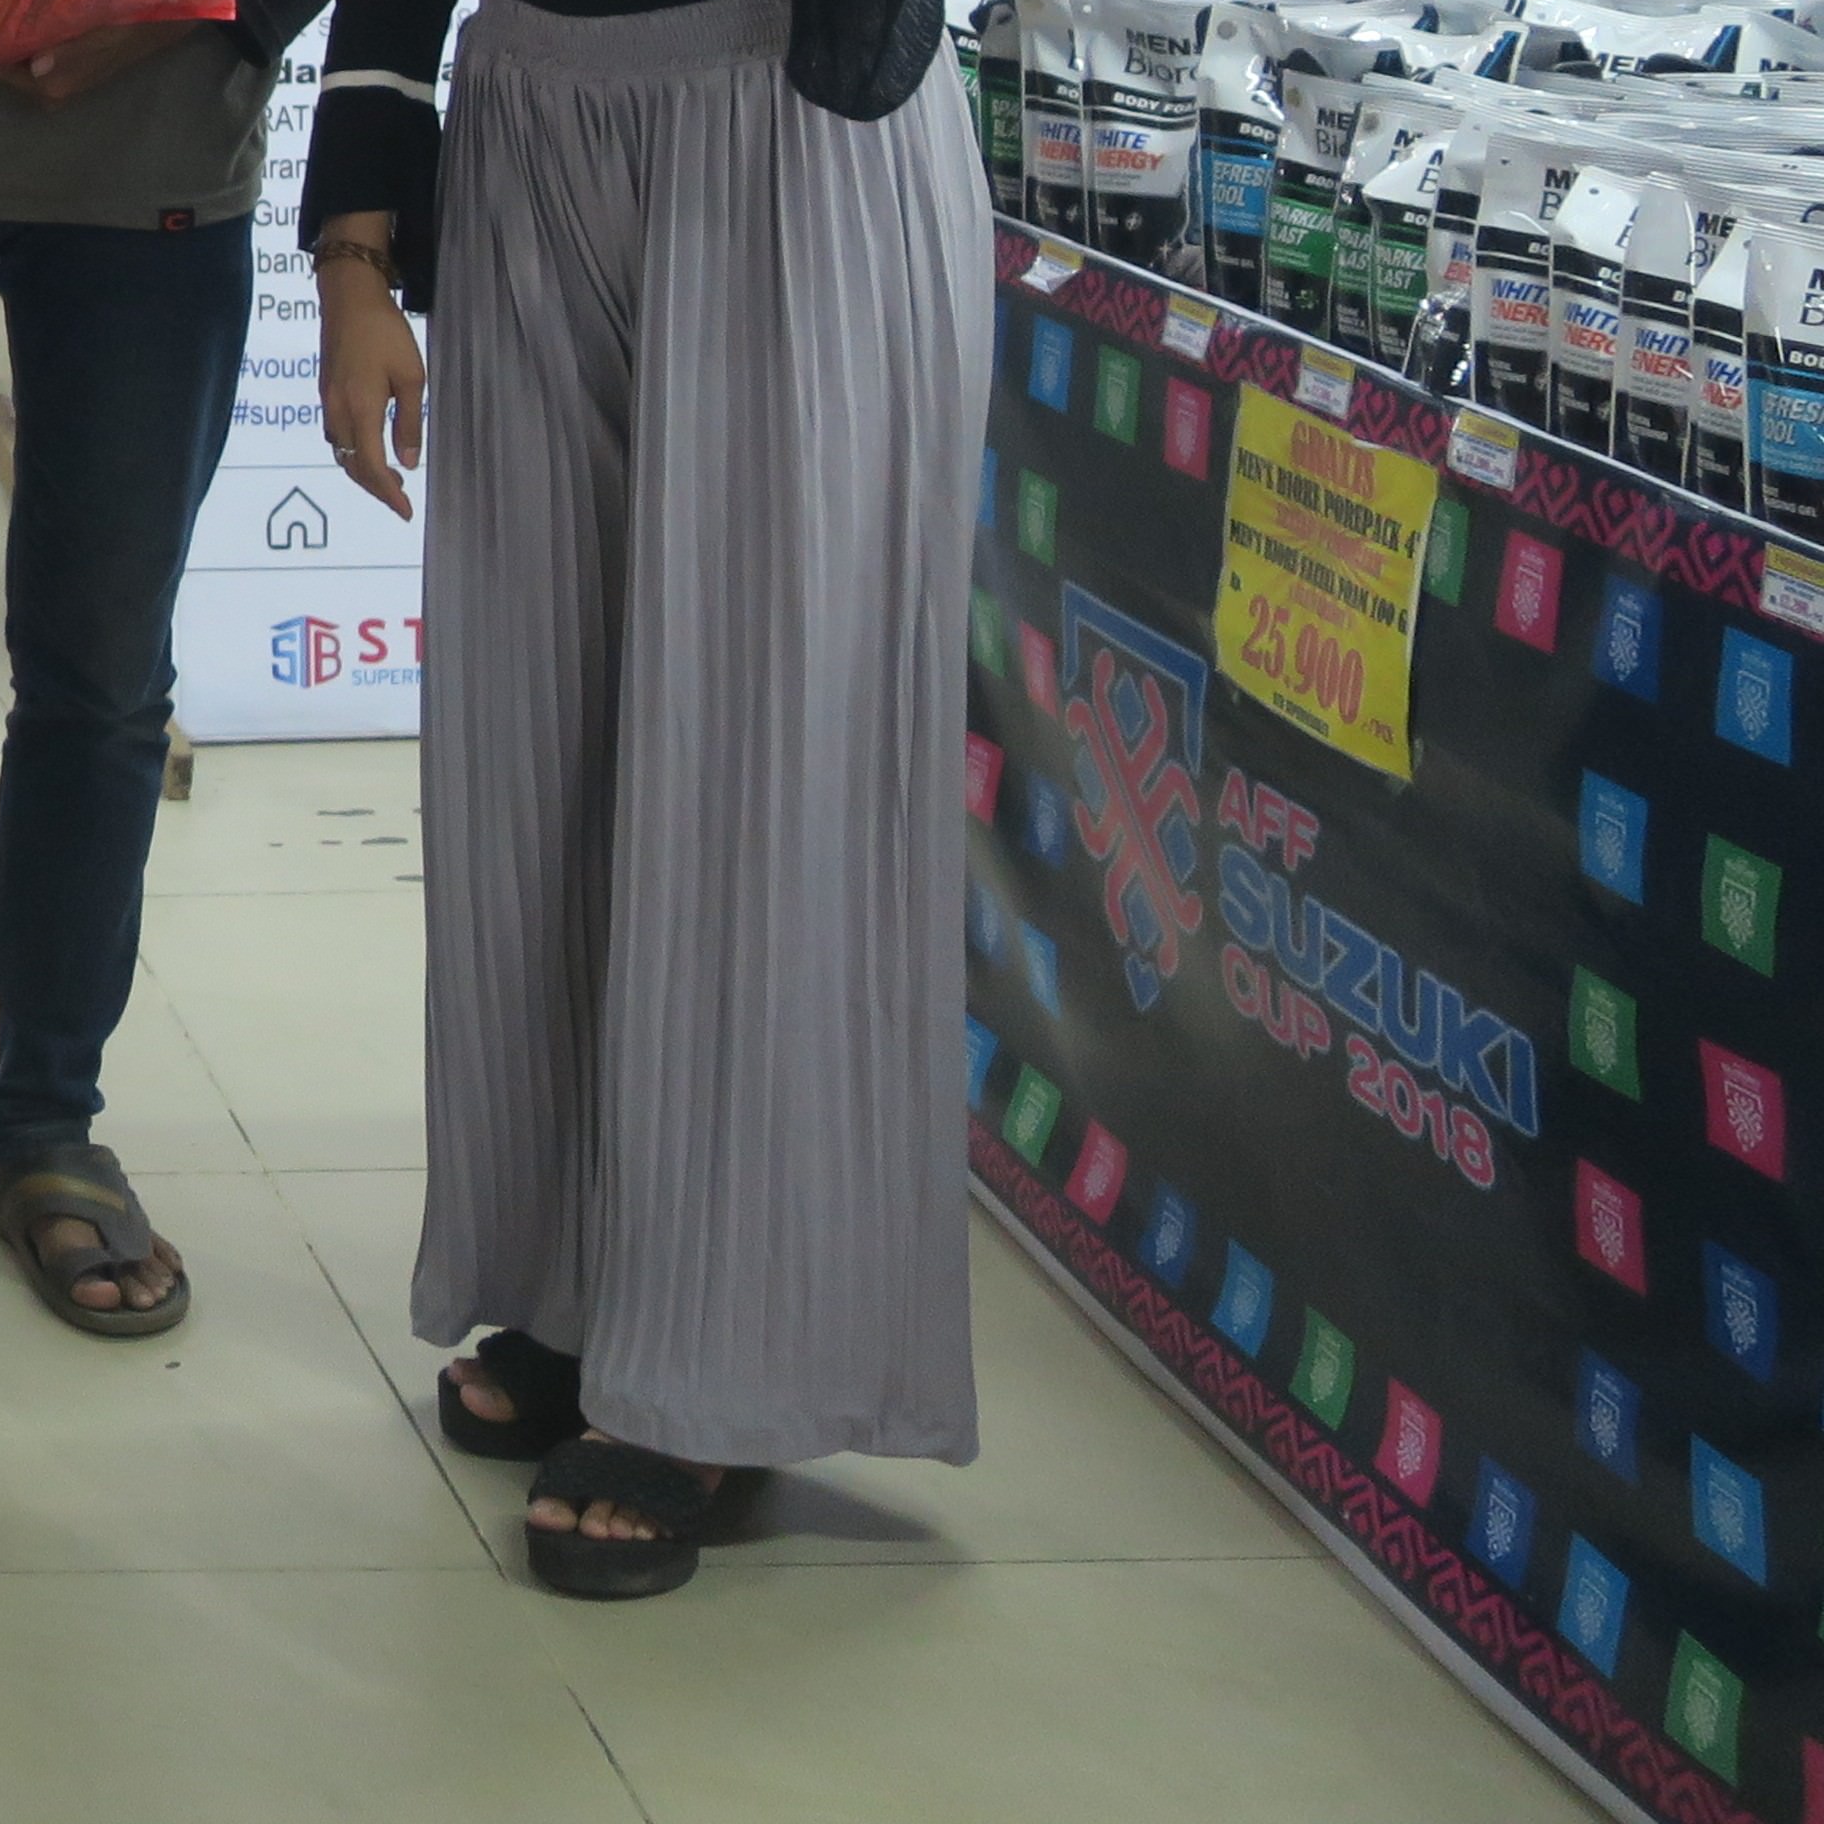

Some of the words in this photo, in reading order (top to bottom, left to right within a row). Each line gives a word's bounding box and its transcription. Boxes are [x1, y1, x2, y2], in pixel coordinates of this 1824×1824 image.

[1112, 92, 1160, 111] BODY
[1323, 484, 1403, 551] POREPACK
[1241, 596, 1366, 724] 25.900
[1216, 765, 1321, 872] AFF
[1215, 842, 1539, 1138] SUZUKI
[1220, 946, 1331, 1061] CUP
[1344, 1033, 1497, 1190] 2018
